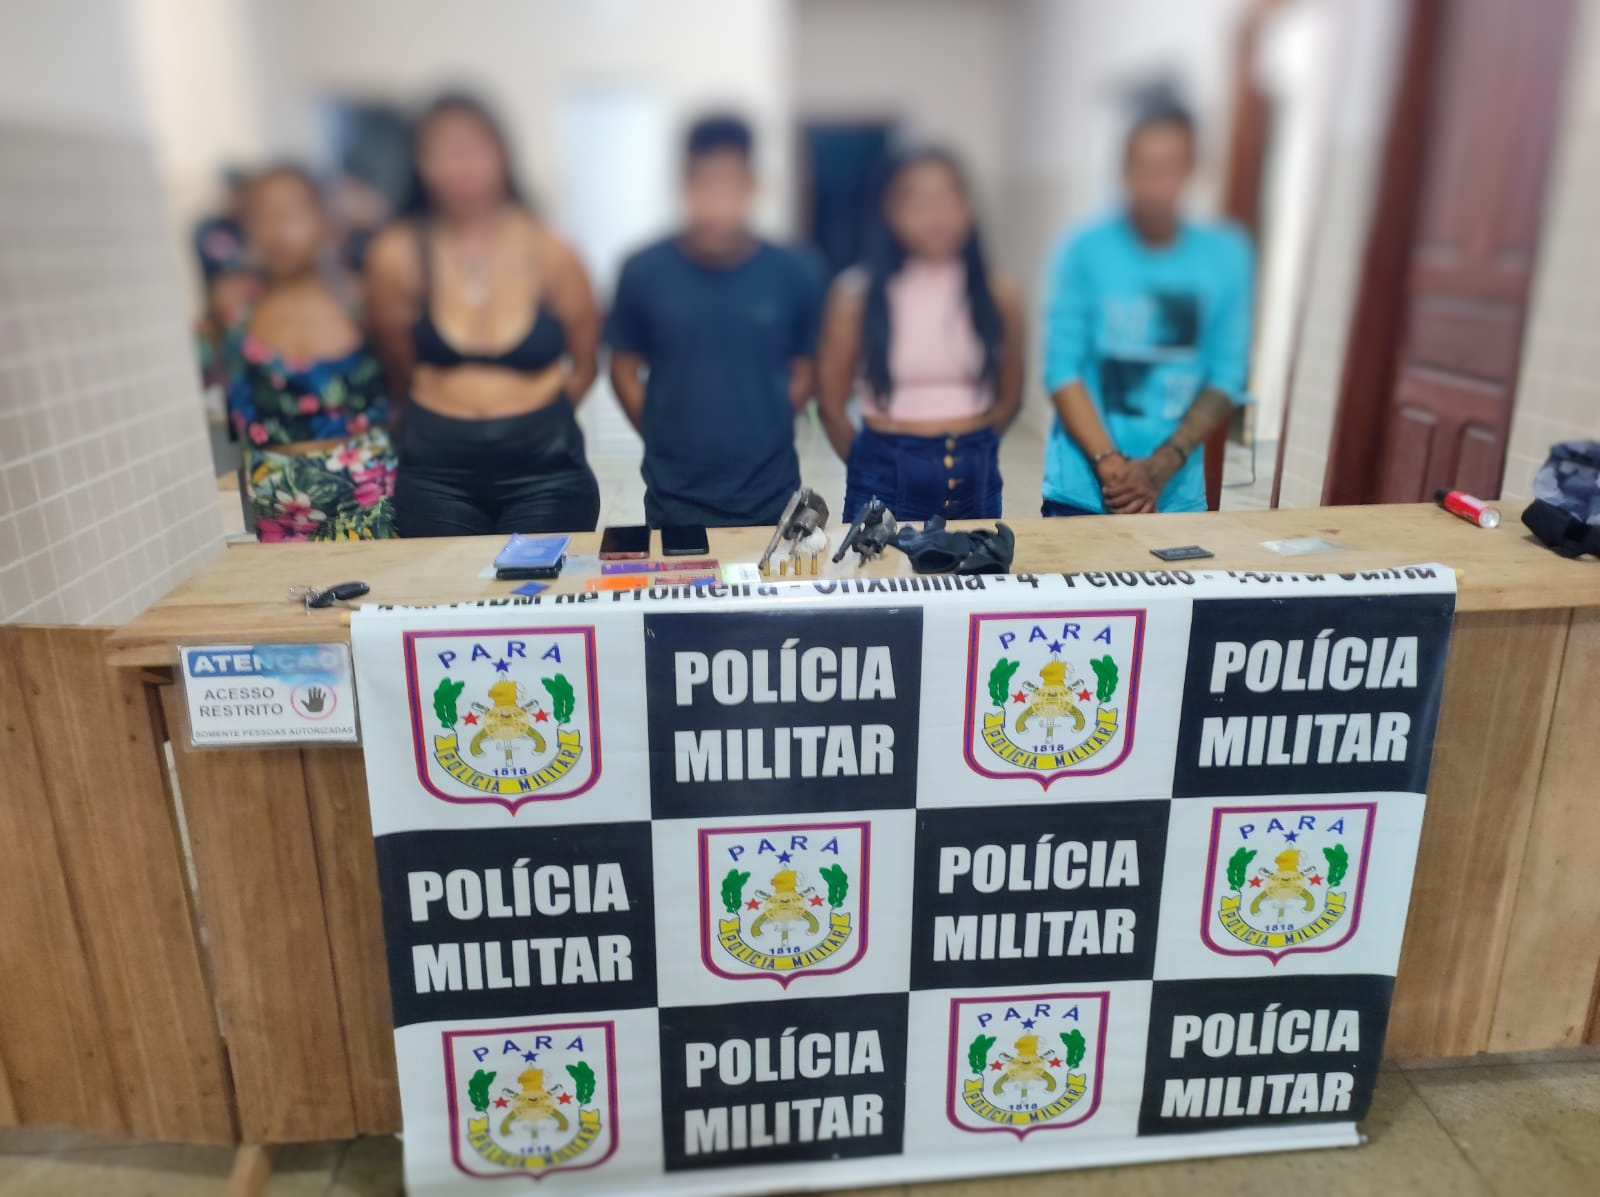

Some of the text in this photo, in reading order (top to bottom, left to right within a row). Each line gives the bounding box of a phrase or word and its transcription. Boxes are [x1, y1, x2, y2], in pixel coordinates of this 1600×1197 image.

[674, 637, 897, 707] POLÍCIA
[1209, 628, 1418, 694] POLÍCIA
[199, 703, 283, 718] RESTRITO
[204, 686, 275, 701] ACESSO
[195, 725, 354, 738] SOMENTE PESSOAS AUTORIZADAS
[1032, 743, 1065, 753] 1818
[1054, 727, 1113, 767] MILITAR
[1198, 711, 1411, 769] MILITAR
[492, 767, 528, 776] 1818
[518, 750, 578, 792] MILITAR
[674, 724, 896, 784] MILITAR
[938, 833, 1141, 895] POLÍCIA
[407, 857, 631, 923] POLÍCIA
[933, 908, 1137, 962] MILITAR
[1264, 923, 1295, 932] 1818
[1285, 908, 1341, 945] MILITAR
[411, 934, 633, 994] MILITAR
[769, 946, 801, 955] 1818
[791, 929, 847, 968] MILITAR
[1169, 1002, 1361, 1059] POLÍCIA
[685, 1026, 885, 1088] POLÍCIA
[1008, 1103, 1038, 1111] 1818
[1029, 1089, 1082, 1122] MILITAR
[1160, 1071, 1354, 1119] MILITAR
[684, 1093, 884, 1157] MILITAR
